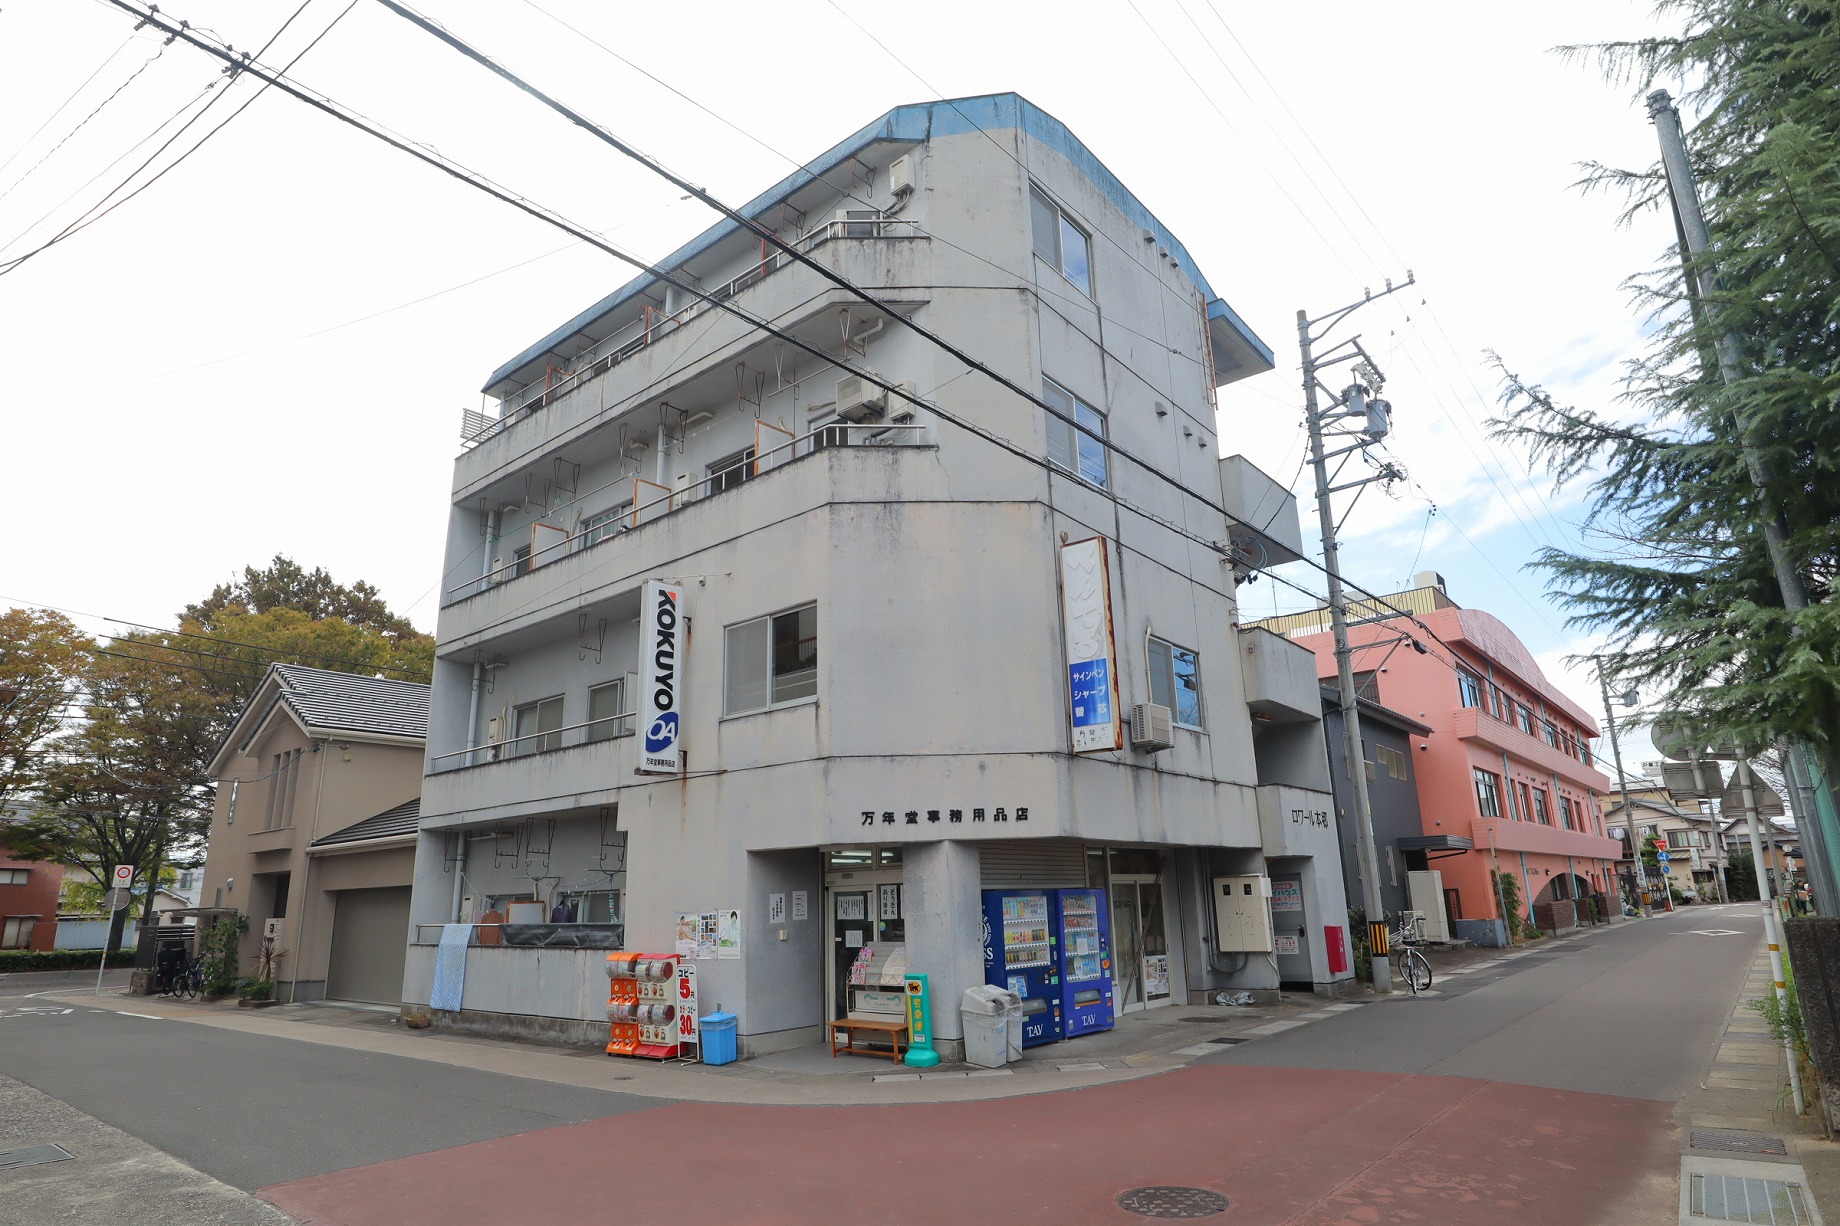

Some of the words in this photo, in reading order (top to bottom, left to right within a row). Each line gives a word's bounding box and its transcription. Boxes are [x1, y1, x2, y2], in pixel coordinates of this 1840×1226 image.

[653, 588, 677, 712] KOKUYO
[1073, 669, 1105, 683] サインペン
[646, 719, 676, 742] OA
[646, 757, 676, 768] 万年堂事務用品店
[861, 806, 1029, 826] 万年堂事務用品店
[1271, 889, 1298, 897] イハウス
[678, 968, 694, 978] コピー
